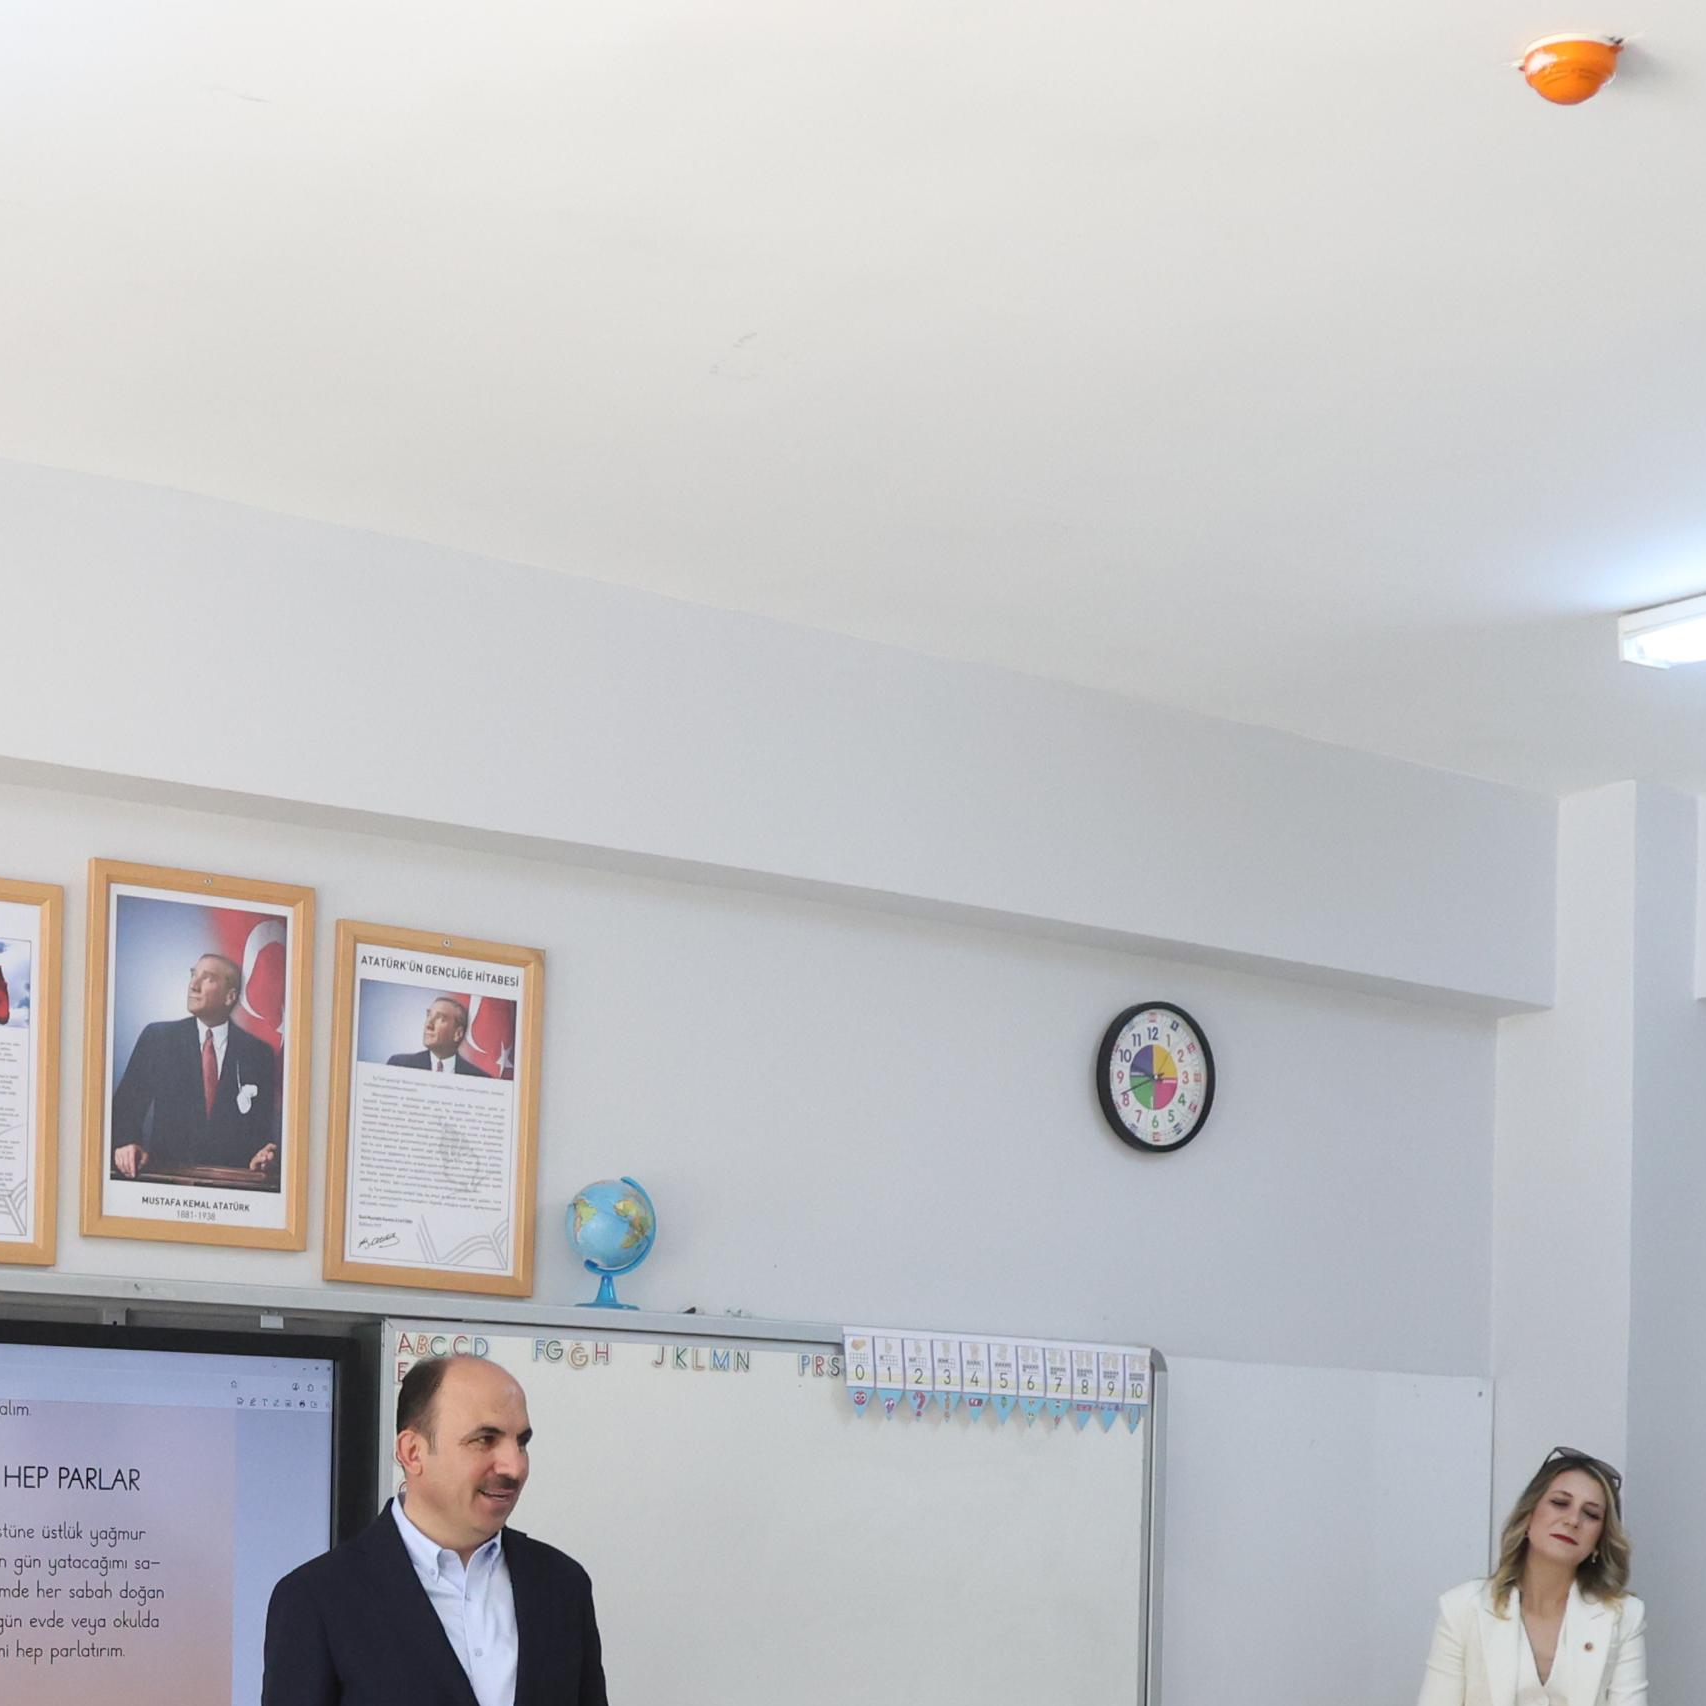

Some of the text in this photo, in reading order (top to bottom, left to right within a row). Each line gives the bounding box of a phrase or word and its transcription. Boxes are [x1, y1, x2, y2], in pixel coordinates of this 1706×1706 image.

[360, 955, 520, 988] ATATÜRK'ÜN GENÇLİĞE HİTABESİ
[1132, 1033, 1141, 1047] 11
[1147, 1027, 1159, 1040] 12
[1166, 1034, 1171, 1047] 1
[1120, 1050, 1132, 1063] 10
[1177, 1051, 1185, 1063] 2
[1117, 1071, 1124, 1084] 9
[1182, 1071, 1189, 1084] 3
[1121, 1093, 1130, 1107] 8
[1178, 1093, 1186, 1106] 4
[1136, 1110, 1142, 1123] 7
[1152, 1115, 1159, 1128] 6
[1168, 1110, 1175, 1123] 5
[141, 1196, 250, 1212] MUSTAFA KEMAL ATATÜRK
[176, 1210, 216, 1221] 1881-1938
[855, 1364, 1143, 1398] 0 1 2 3 4 5 6 7 8 9 10
[4, 1465, 49, 1488] HEP
[58, 1467, 140, 1491] PARLAR
[42, 1521, 83, 1539] üstlük
[90, 1527, 146, 1548] yağmur
[14, 1555, 41, 1576] gün
[48, 1554, 127, 1576] yatacağımı
[135, 1558, 161, 1570] sa-
[36, 1580, 62, 1599] her
[69, 1581, 112, 1599] sabah
[119, 1581, 165, 1606] doğan
[29, 1609, 64, 1628] evde
[71, 1618, 106, 1635] veya
[113, 1609, 159, 1628] okulda
[16, 1640, 43, 1664] hep
[50, 1640, 125, 1664] parlatırım.
